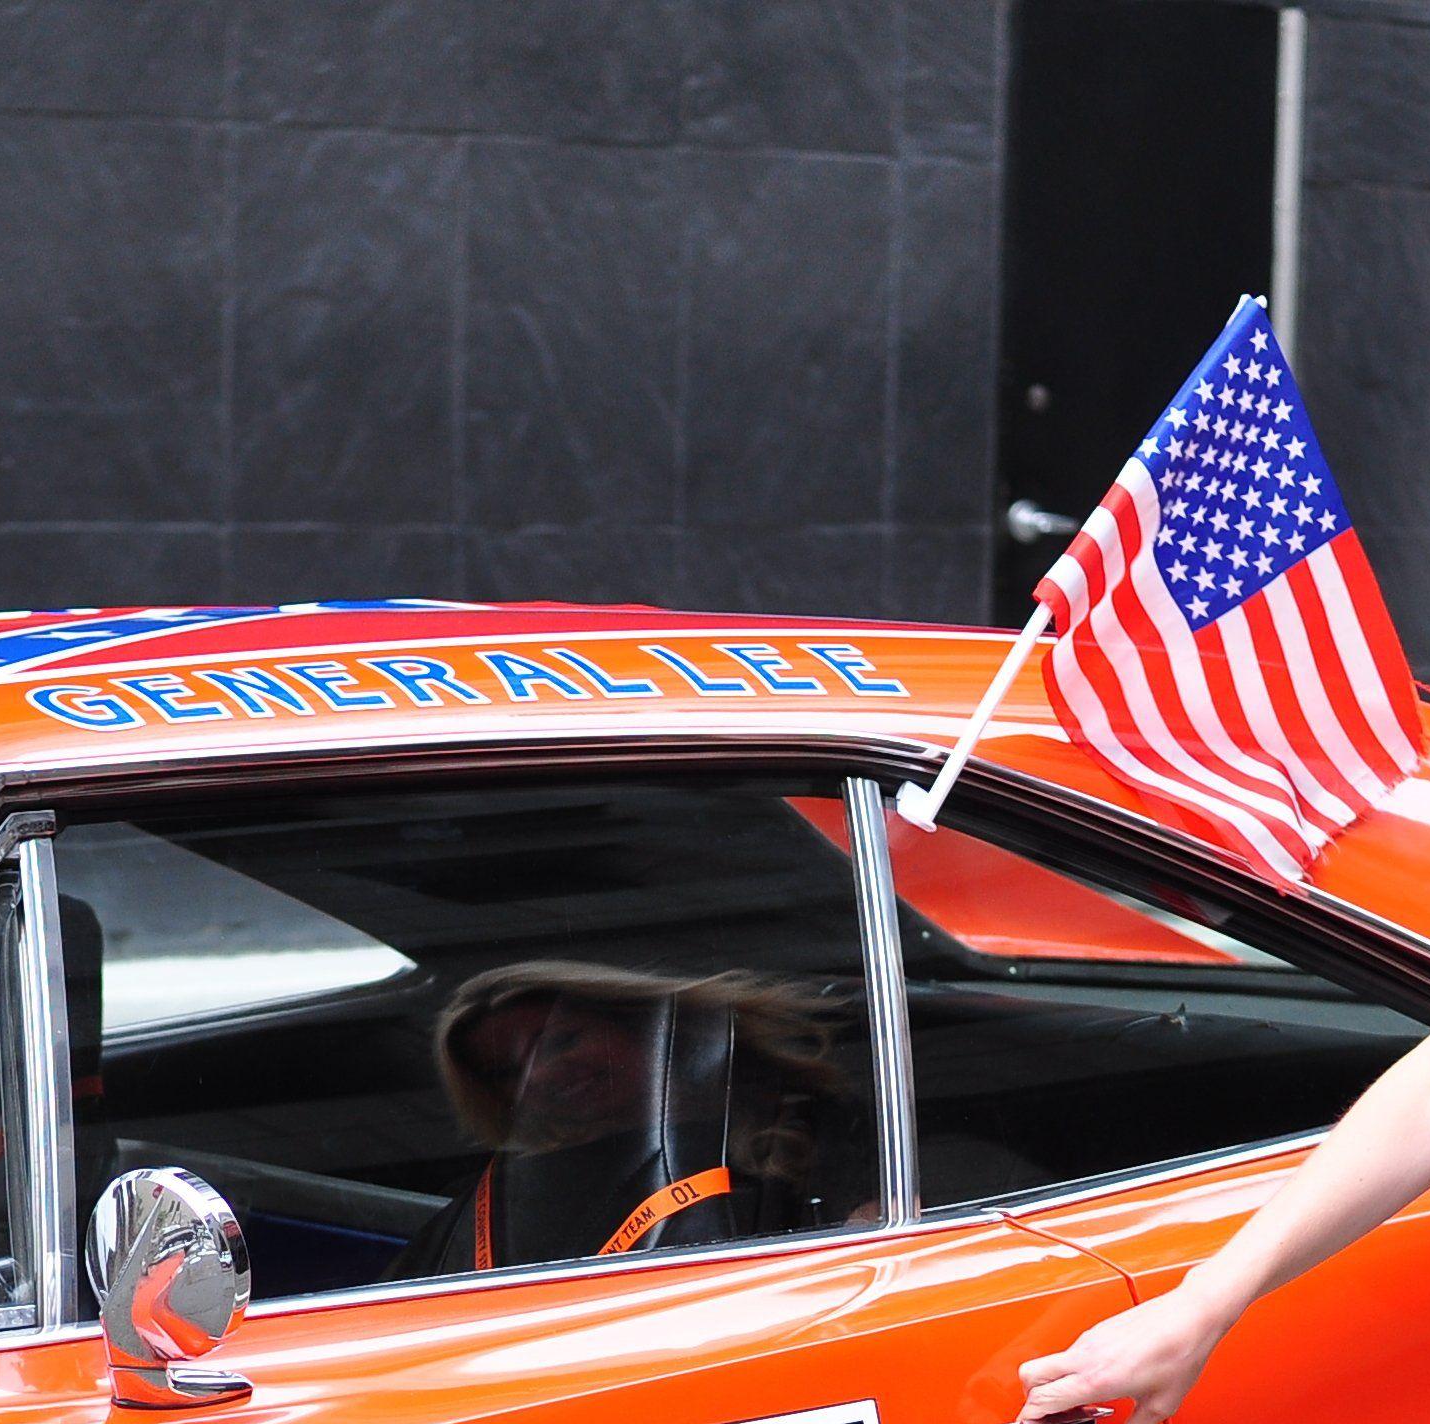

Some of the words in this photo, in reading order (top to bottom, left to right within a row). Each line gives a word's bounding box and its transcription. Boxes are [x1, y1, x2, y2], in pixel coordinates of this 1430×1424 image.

[25, 645, 654, 732] GENERAL
[639, 643, 910, 698] LEE
[622, 1206, 656, 1239] TEAM
[671, 1182, 701, 1205] 01
